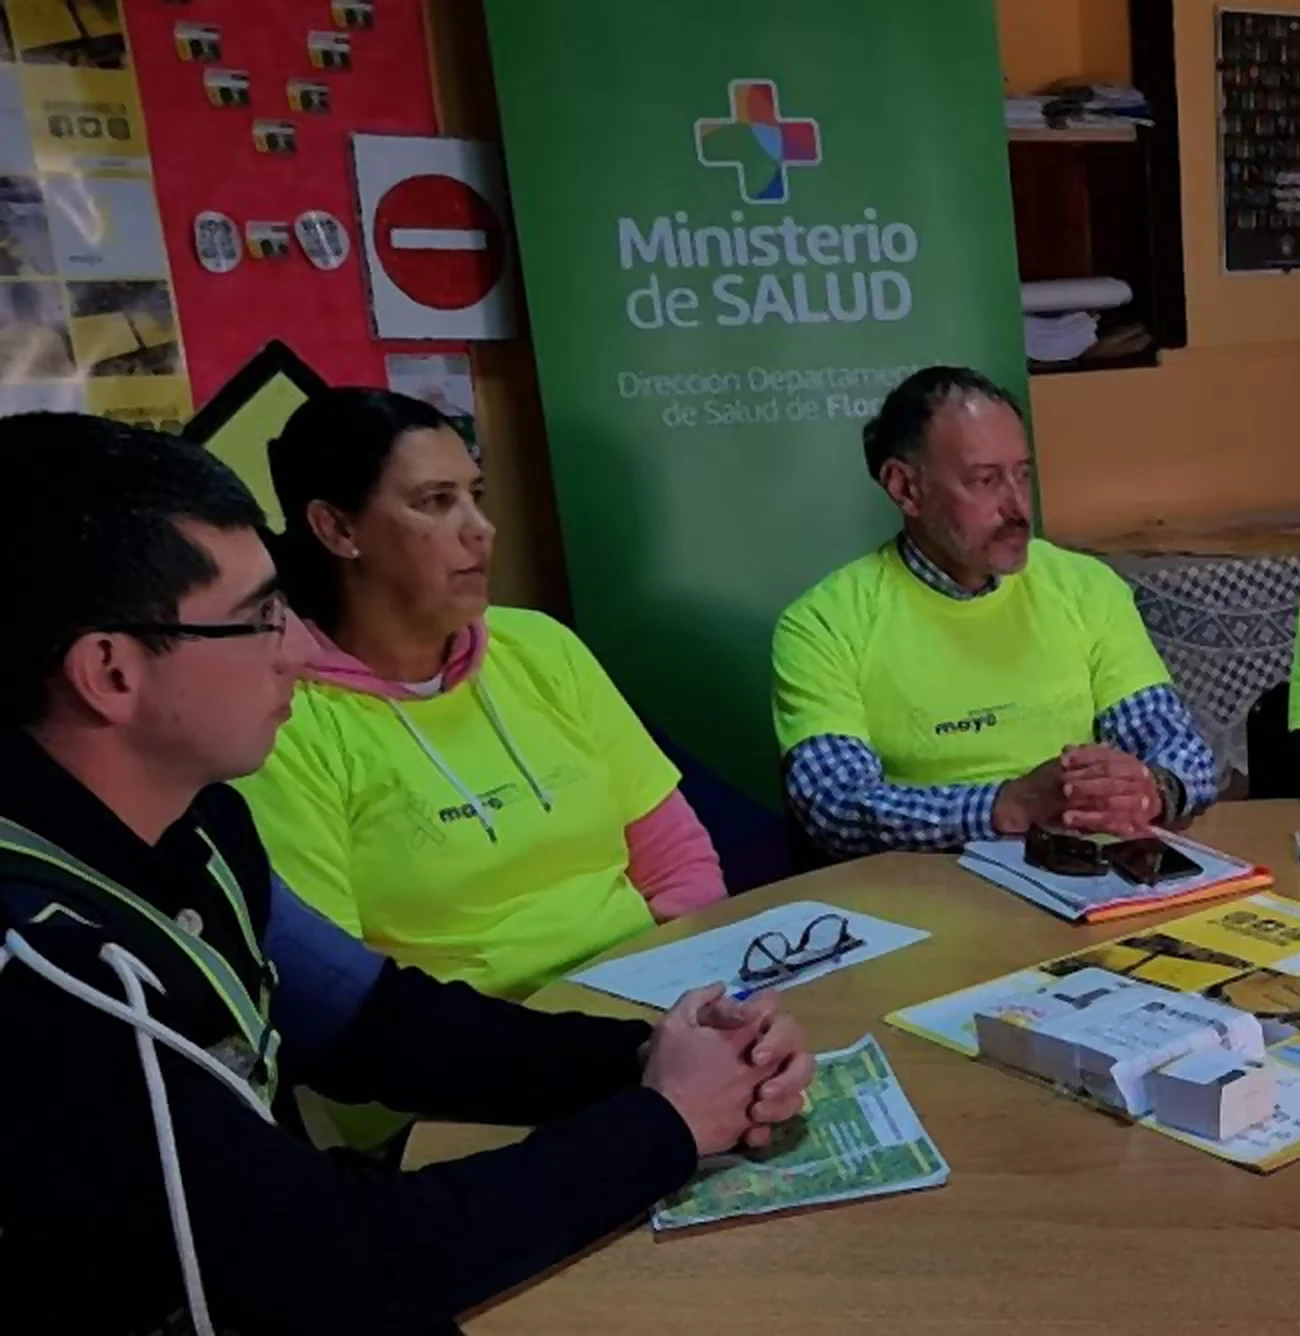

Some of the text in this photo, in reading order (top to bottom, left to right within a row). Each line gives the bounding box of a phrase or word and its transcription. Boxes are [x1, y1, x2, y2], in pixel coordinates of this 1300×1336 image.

[618, 207, 918, 269] Ministerio
[626, 270, 913, 329] de SALUD
[661, 401, 697, 427] de
[704, 398, 779, 426] Salud
[786, 396, 820, 422] de
